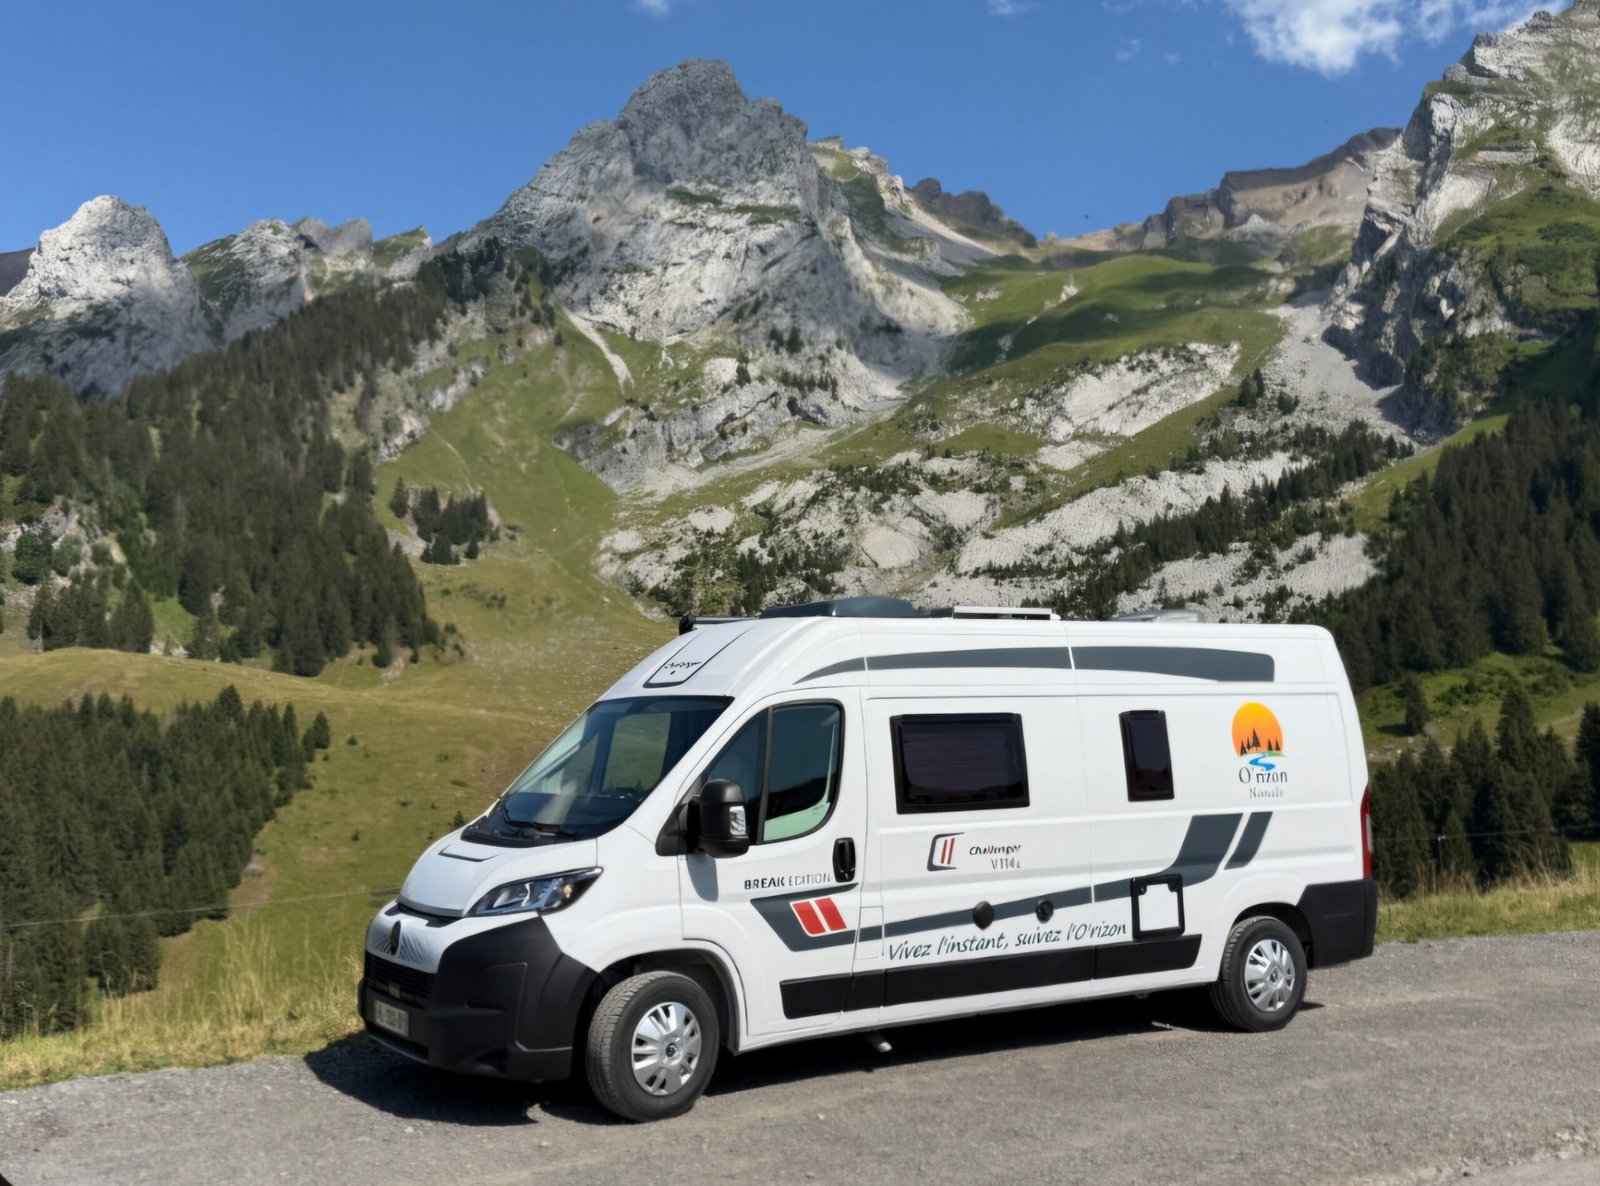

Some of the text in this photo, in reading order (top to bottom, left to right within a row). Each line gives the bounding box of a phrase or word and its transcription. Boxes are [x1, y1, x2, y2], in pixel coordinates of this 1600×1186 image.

[744, 876, 785, 890] BREAK
[889, 940, 932, 960] Vivez
[937, 932, 1008, 955] l'instant,
[1015, 926, 1062, 947] suivez
